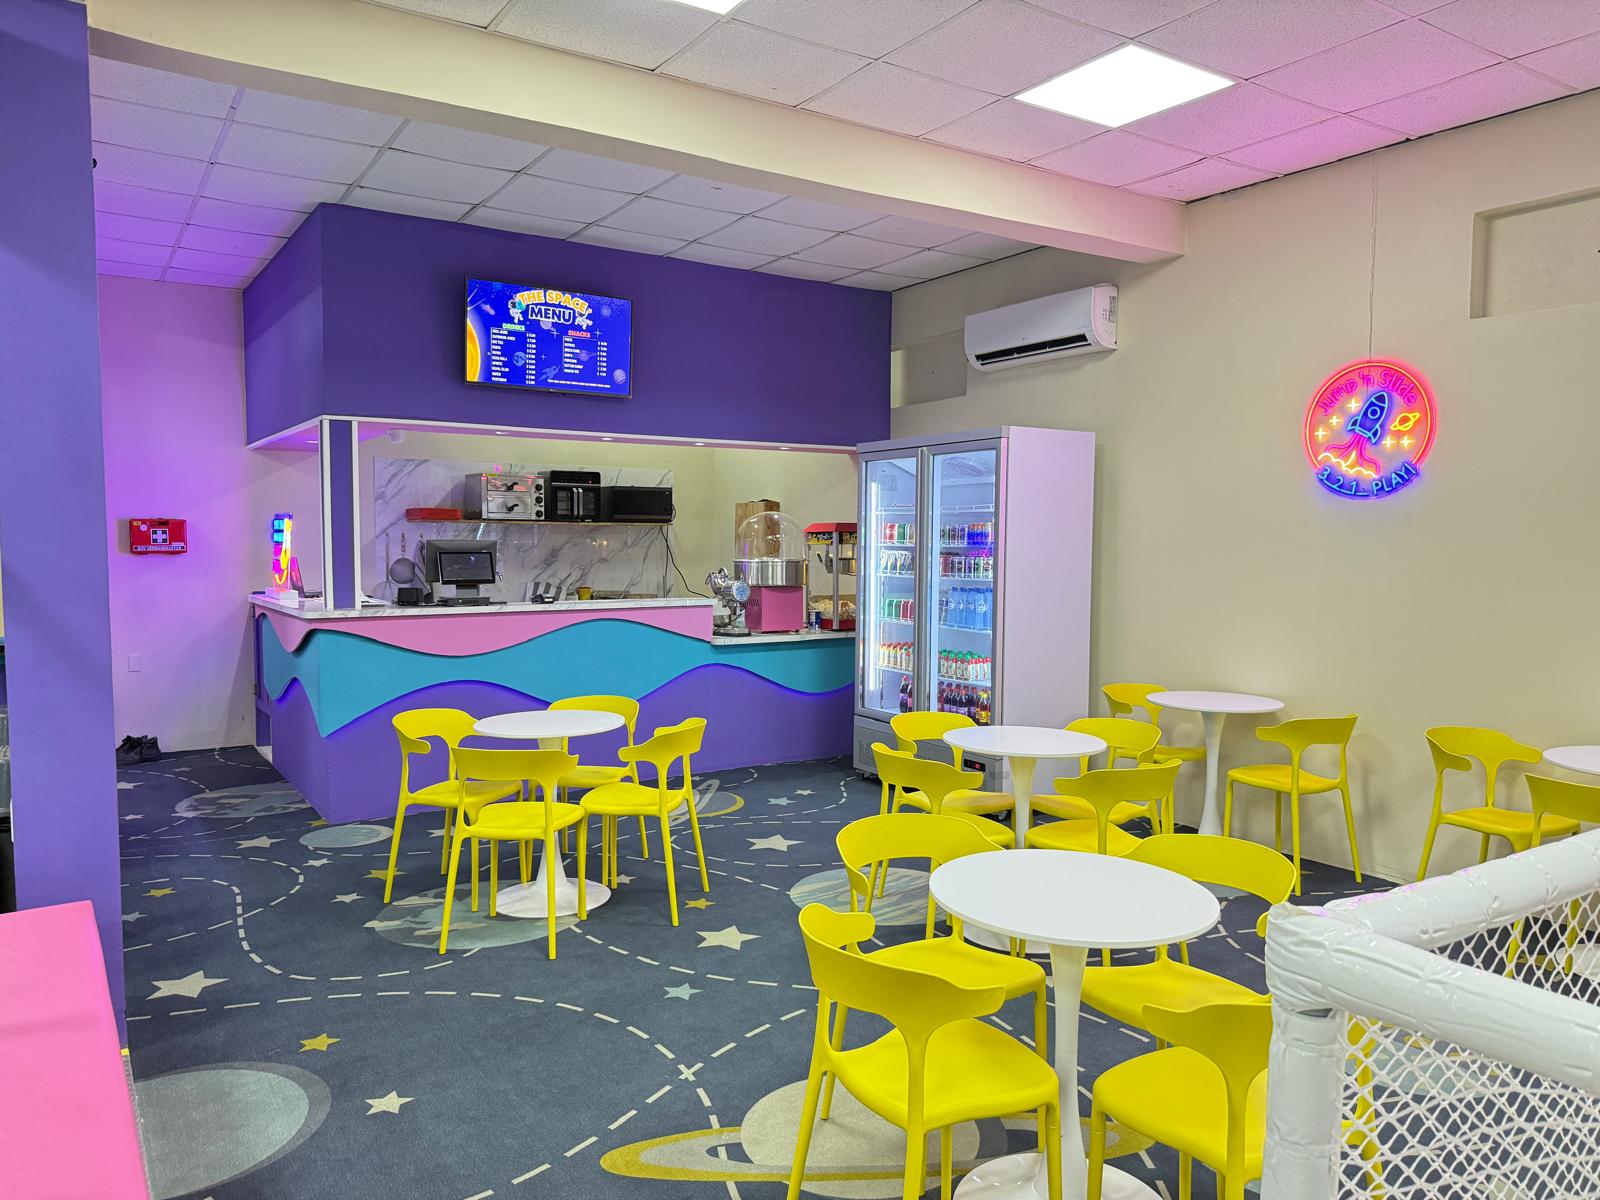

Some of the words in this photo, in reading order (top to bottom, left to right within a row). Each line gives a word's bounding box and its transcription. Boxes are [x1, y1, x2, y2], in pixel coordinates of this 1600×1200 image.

[518, 290, 545, 305] THE
[547, 290, 588, 313] SPACE
[529, 305, 573, 324] MENU
[1318, 378, 1358, 416] Jump
[1377, 370, 1417, 406] Slide
